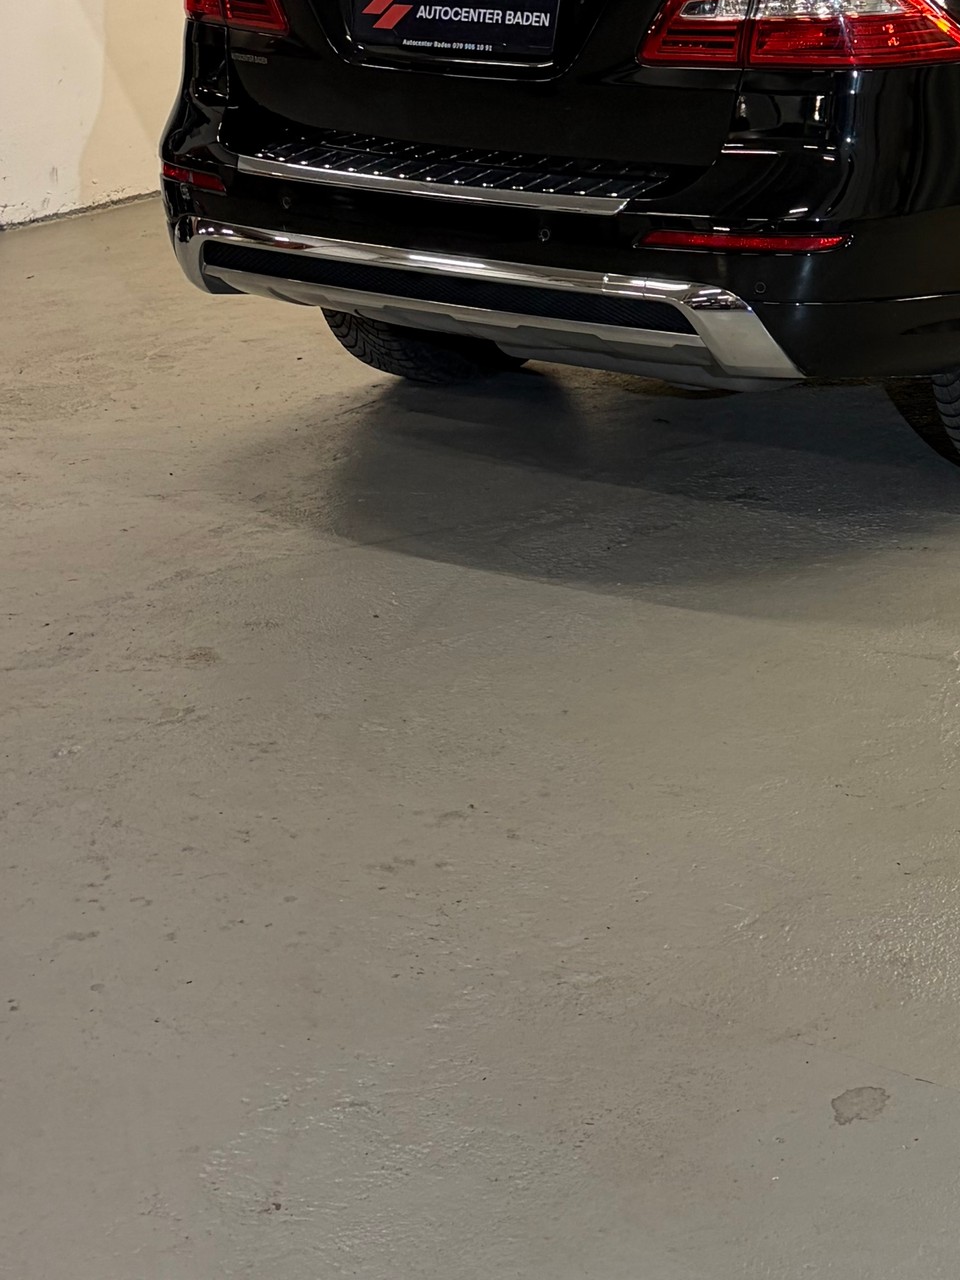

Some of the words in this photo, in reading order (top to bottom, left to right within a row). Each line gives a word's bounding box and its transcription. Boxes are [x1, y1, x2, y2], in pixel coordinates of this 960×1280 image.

[416, 5, 502, 24] AUTOCENTER
[505, 10, 550, 27] BADEN
[402, 39, 433, 48] Autocenter
[433, 41, 451, 49] Baden
